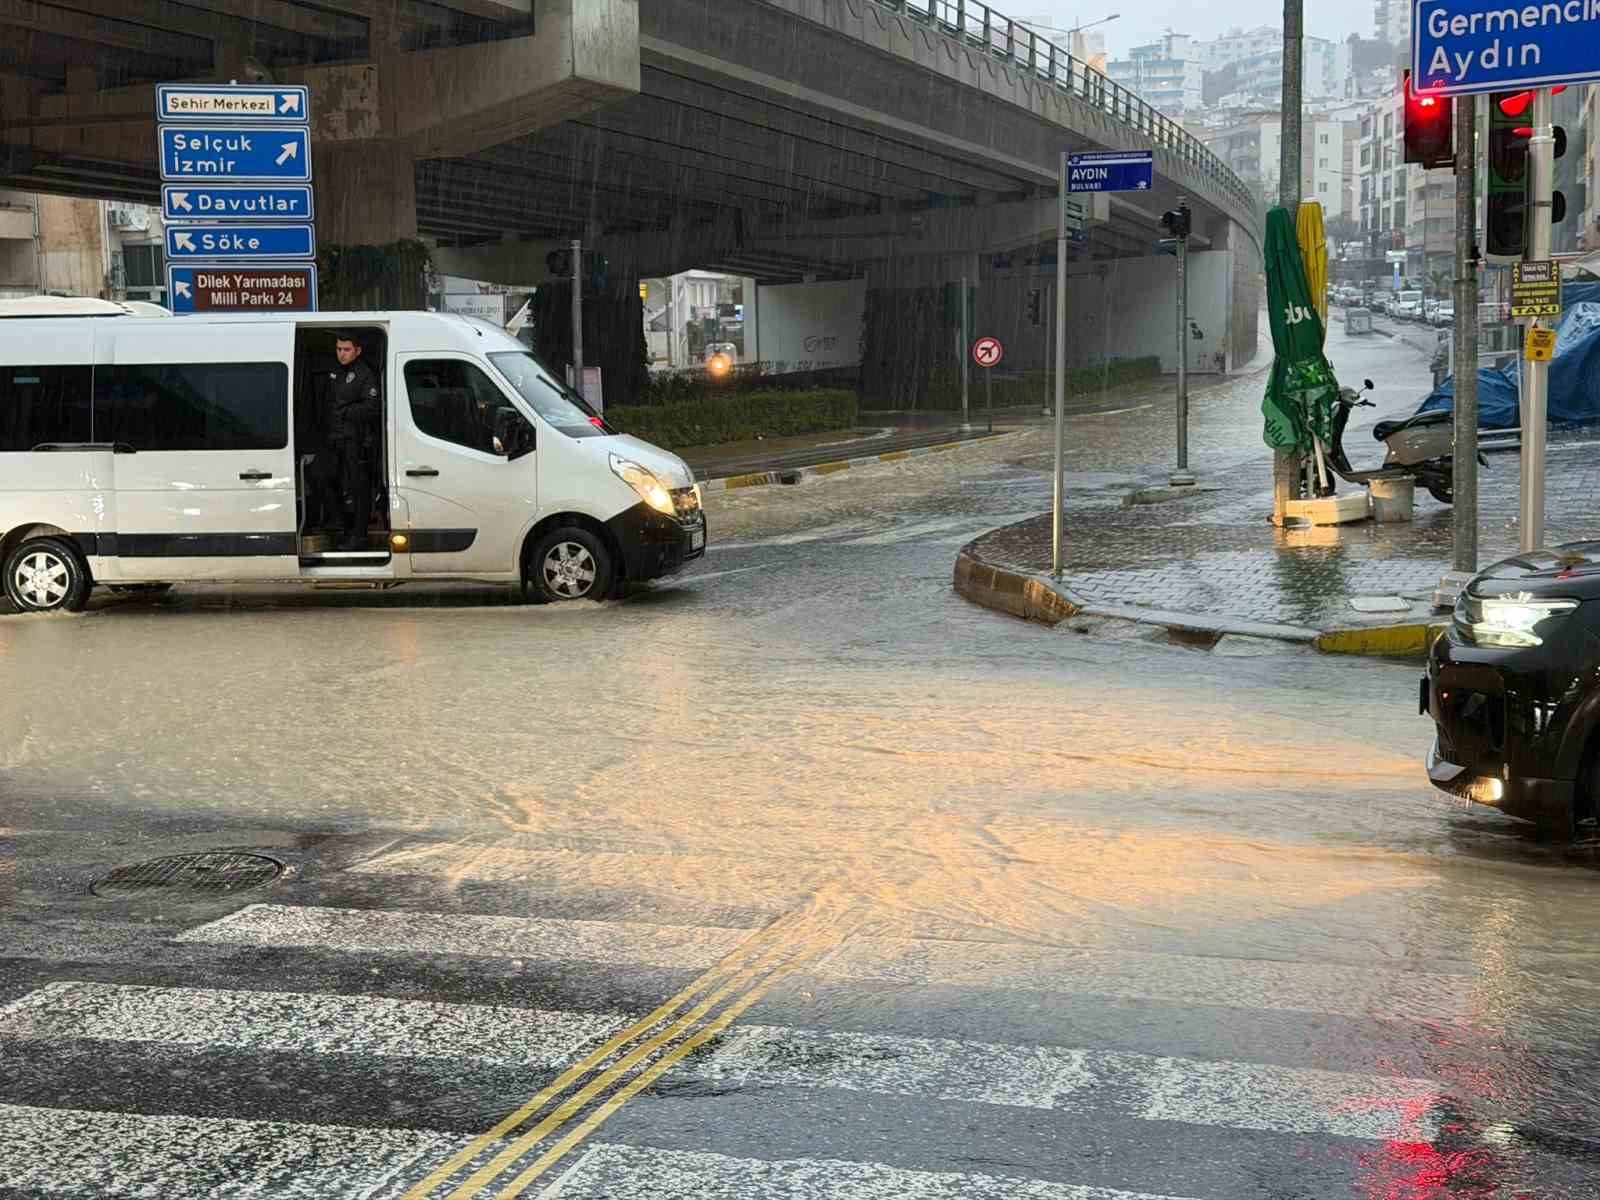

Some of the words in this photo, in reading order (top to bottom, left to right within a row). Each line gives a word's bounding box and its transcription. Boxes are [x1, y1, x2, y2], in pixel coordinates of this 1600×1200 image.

[1427, 38, 1541, 81] Aydın
[170, 97, 209, 110] Şehir
[213, 98, 271, 111] Merkezi
[173, 134, 252, 153] Selçuk
[173, 152, 236, 172] İzmir
[1071, 167, 1108, 180] AYDIN
[198, 194, 298, 211] Davutlar
[202, 233, 260, 250] Söke
[197, 274, 231, 288] Dilek
[233, 274, 306, 289] Yarımadası
[211, 292, 237, 305] Milli
[241, 292, 274, 305] Parkı
[278, 292, 294, 305] 24
[1514, 306, 1557, 314] TAXI
